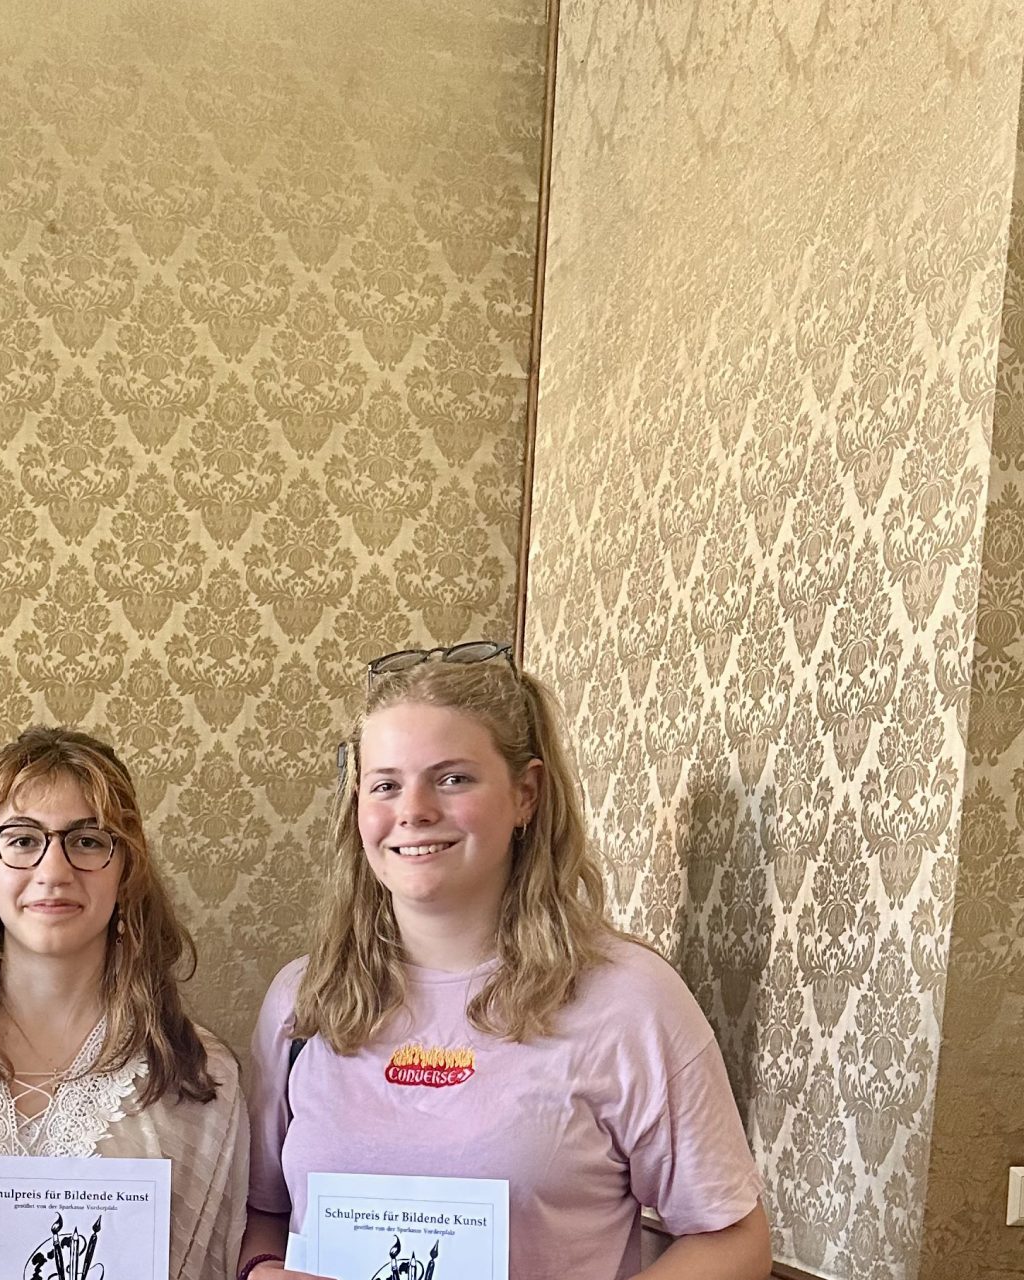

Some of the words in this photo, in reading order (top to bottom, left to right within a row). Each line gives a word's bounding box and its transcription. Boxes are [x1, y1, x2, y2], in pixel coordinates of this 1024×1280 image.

[388, 1066, 457, 1084] CONVERSE
[45, 1189, 61, 1200] für
[64, 1190, 113, 1201] Bildende
[116, 1192, 149, 1202] Kunst
[325, 1208, 379, 1222] Schulpreis
[383, 1211, 399, 1221] für
[402, 1212, 450, 1225] Bildende
[453, 1215, 487, 1226] Kunst
